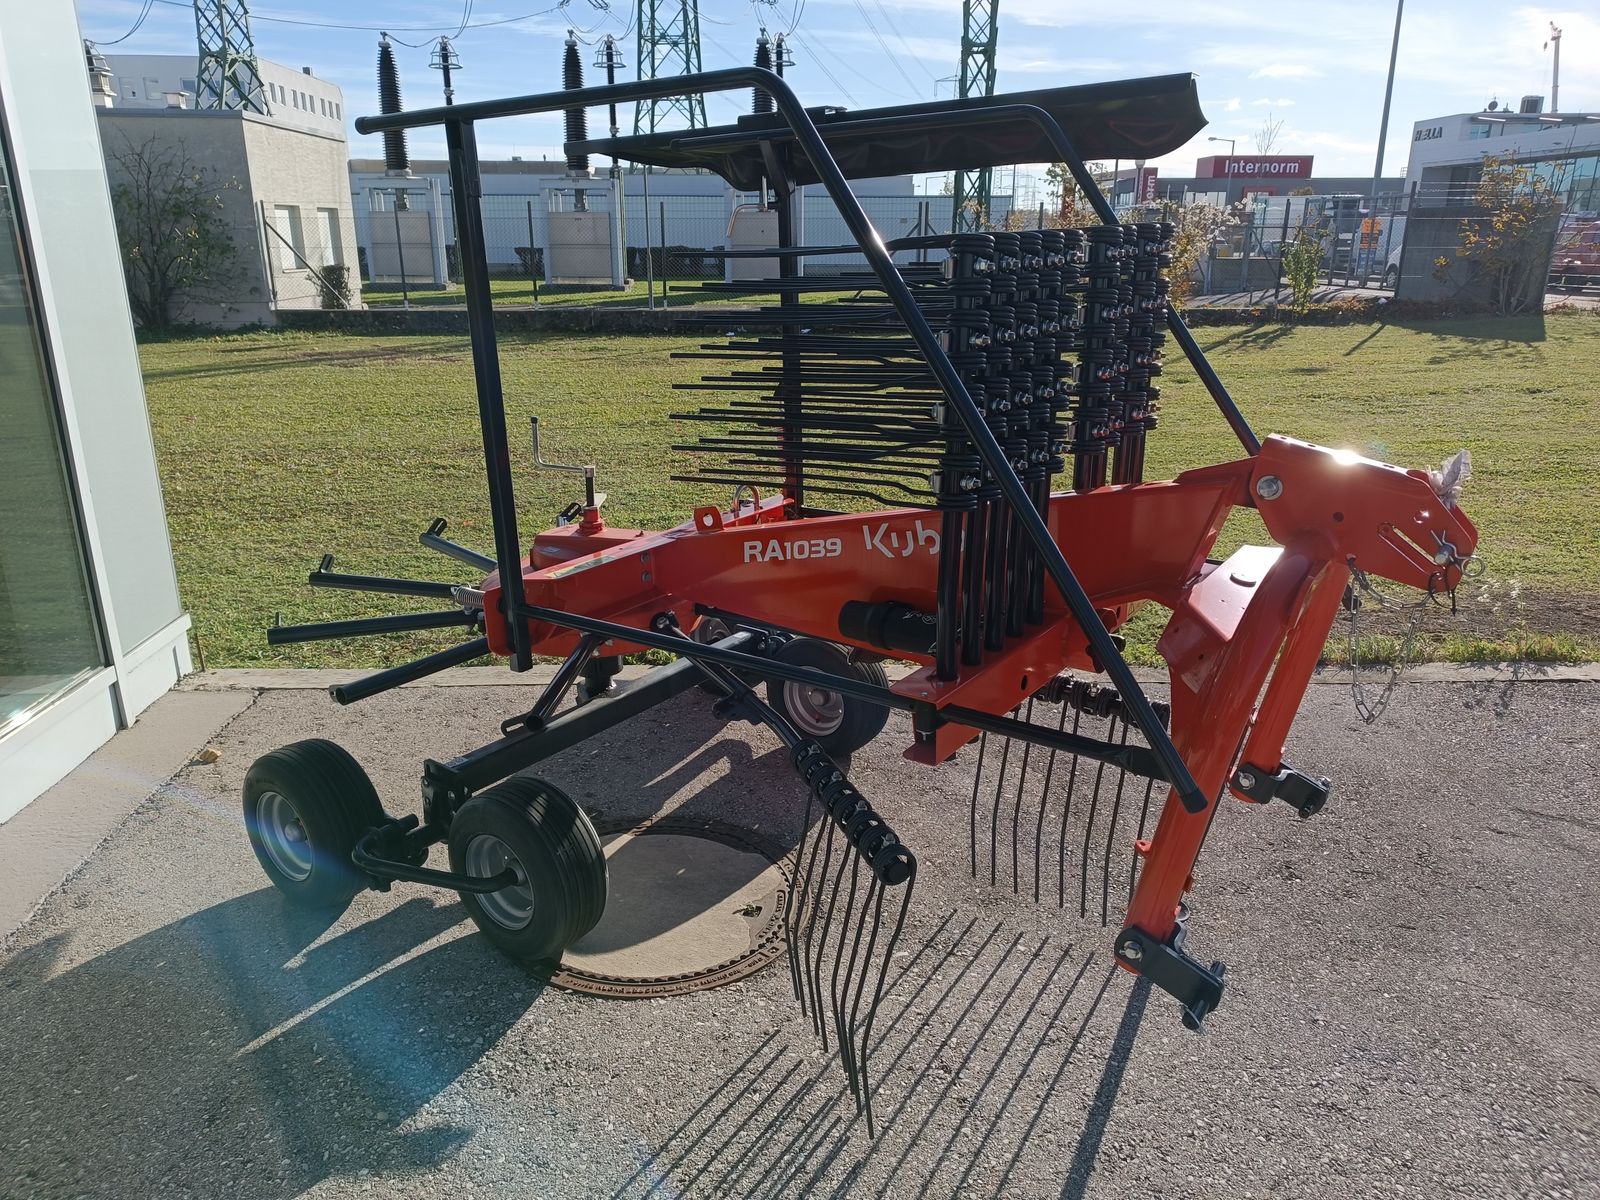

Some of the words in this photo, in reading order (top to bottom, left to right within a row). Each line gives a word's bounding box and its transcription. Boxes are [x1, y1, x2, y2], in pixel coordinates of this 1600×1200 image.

[1224, 159, 1300, 174] Internorm
[743, 537, 842, 563] RA1039
[862, 519, 942, 558] Kub
